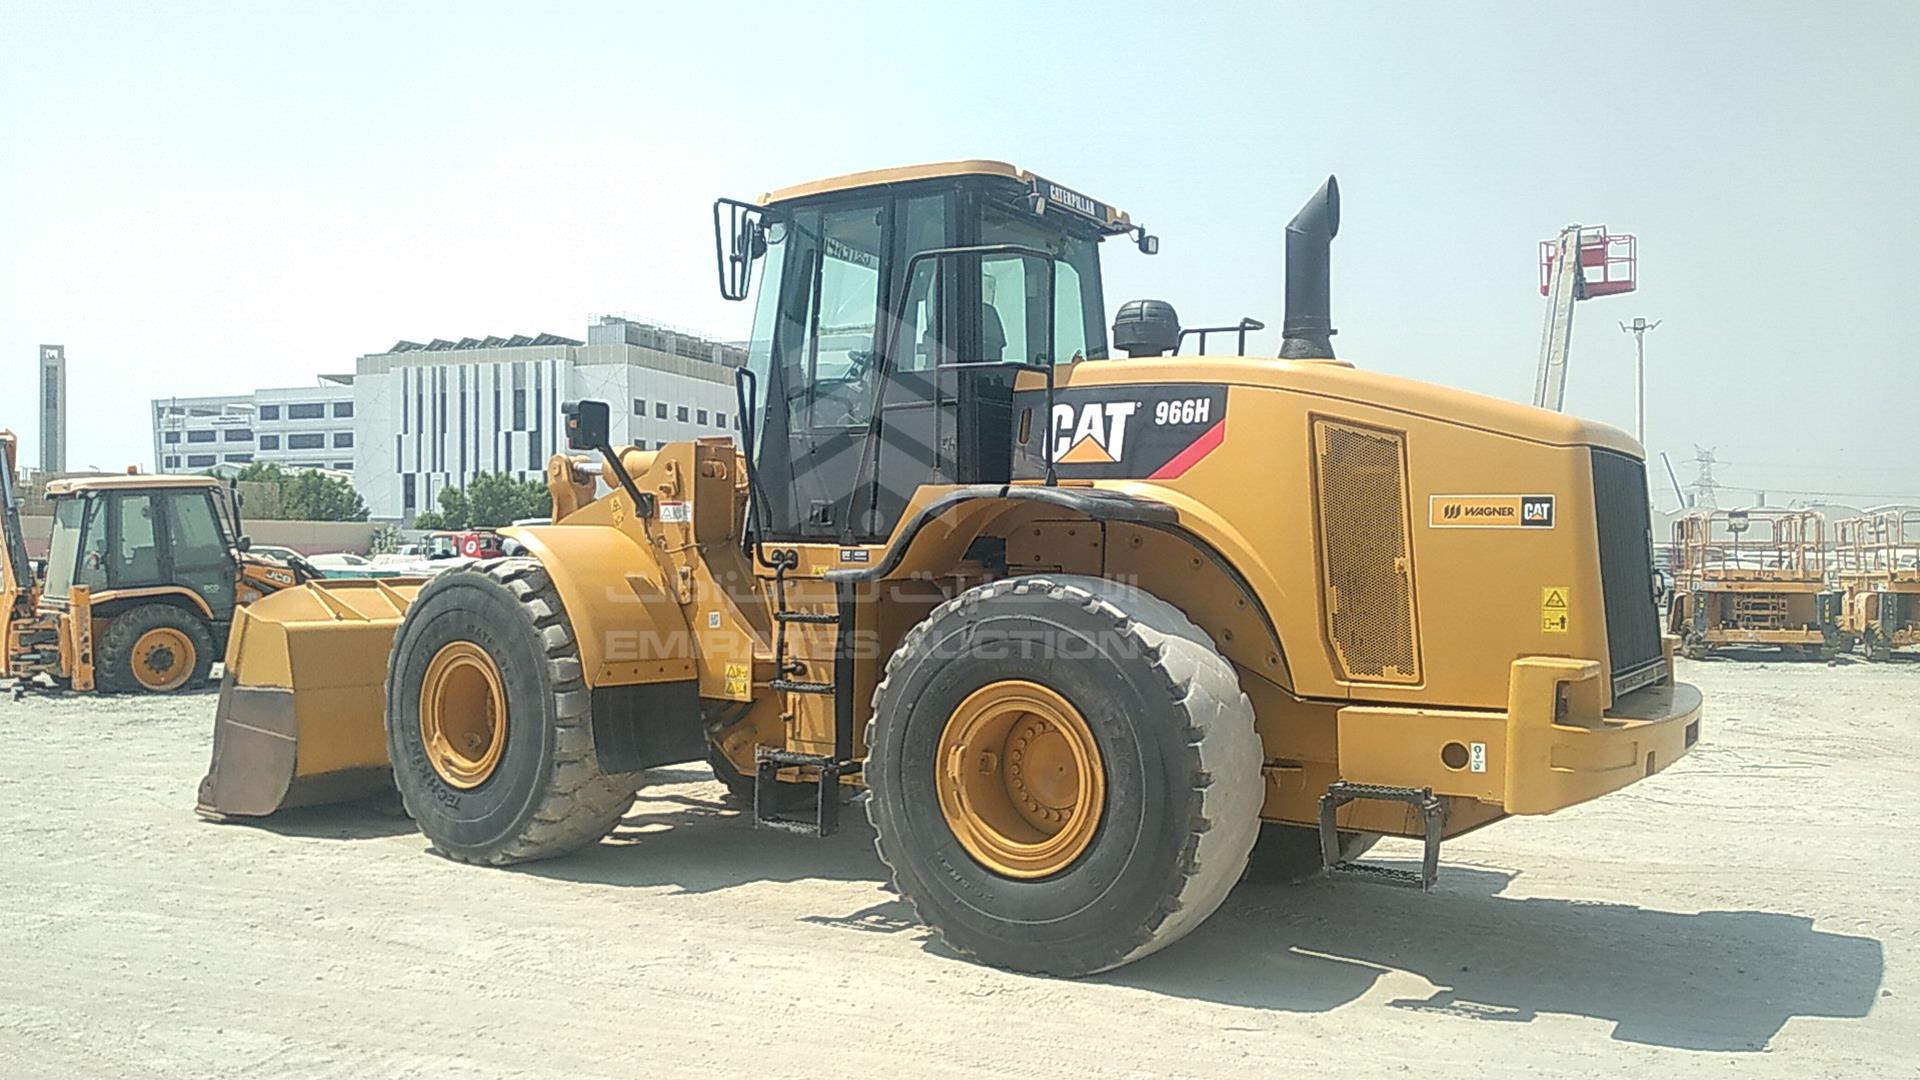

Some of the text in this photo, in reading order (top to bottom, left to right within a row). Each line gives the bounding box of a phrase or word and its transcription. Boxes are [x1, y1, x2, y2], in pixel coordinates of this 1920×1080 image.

[1050, 184, 1095, 216] CATERPILLAR
[1155, 398, 1210, 425] 966H
[1042, 402, 1136, 463] CAT
[1465, 506, 1515, 517] WAGNER
[1524, 503, 1550, 520] CAT
[266, 570, 292, 584] JCB
